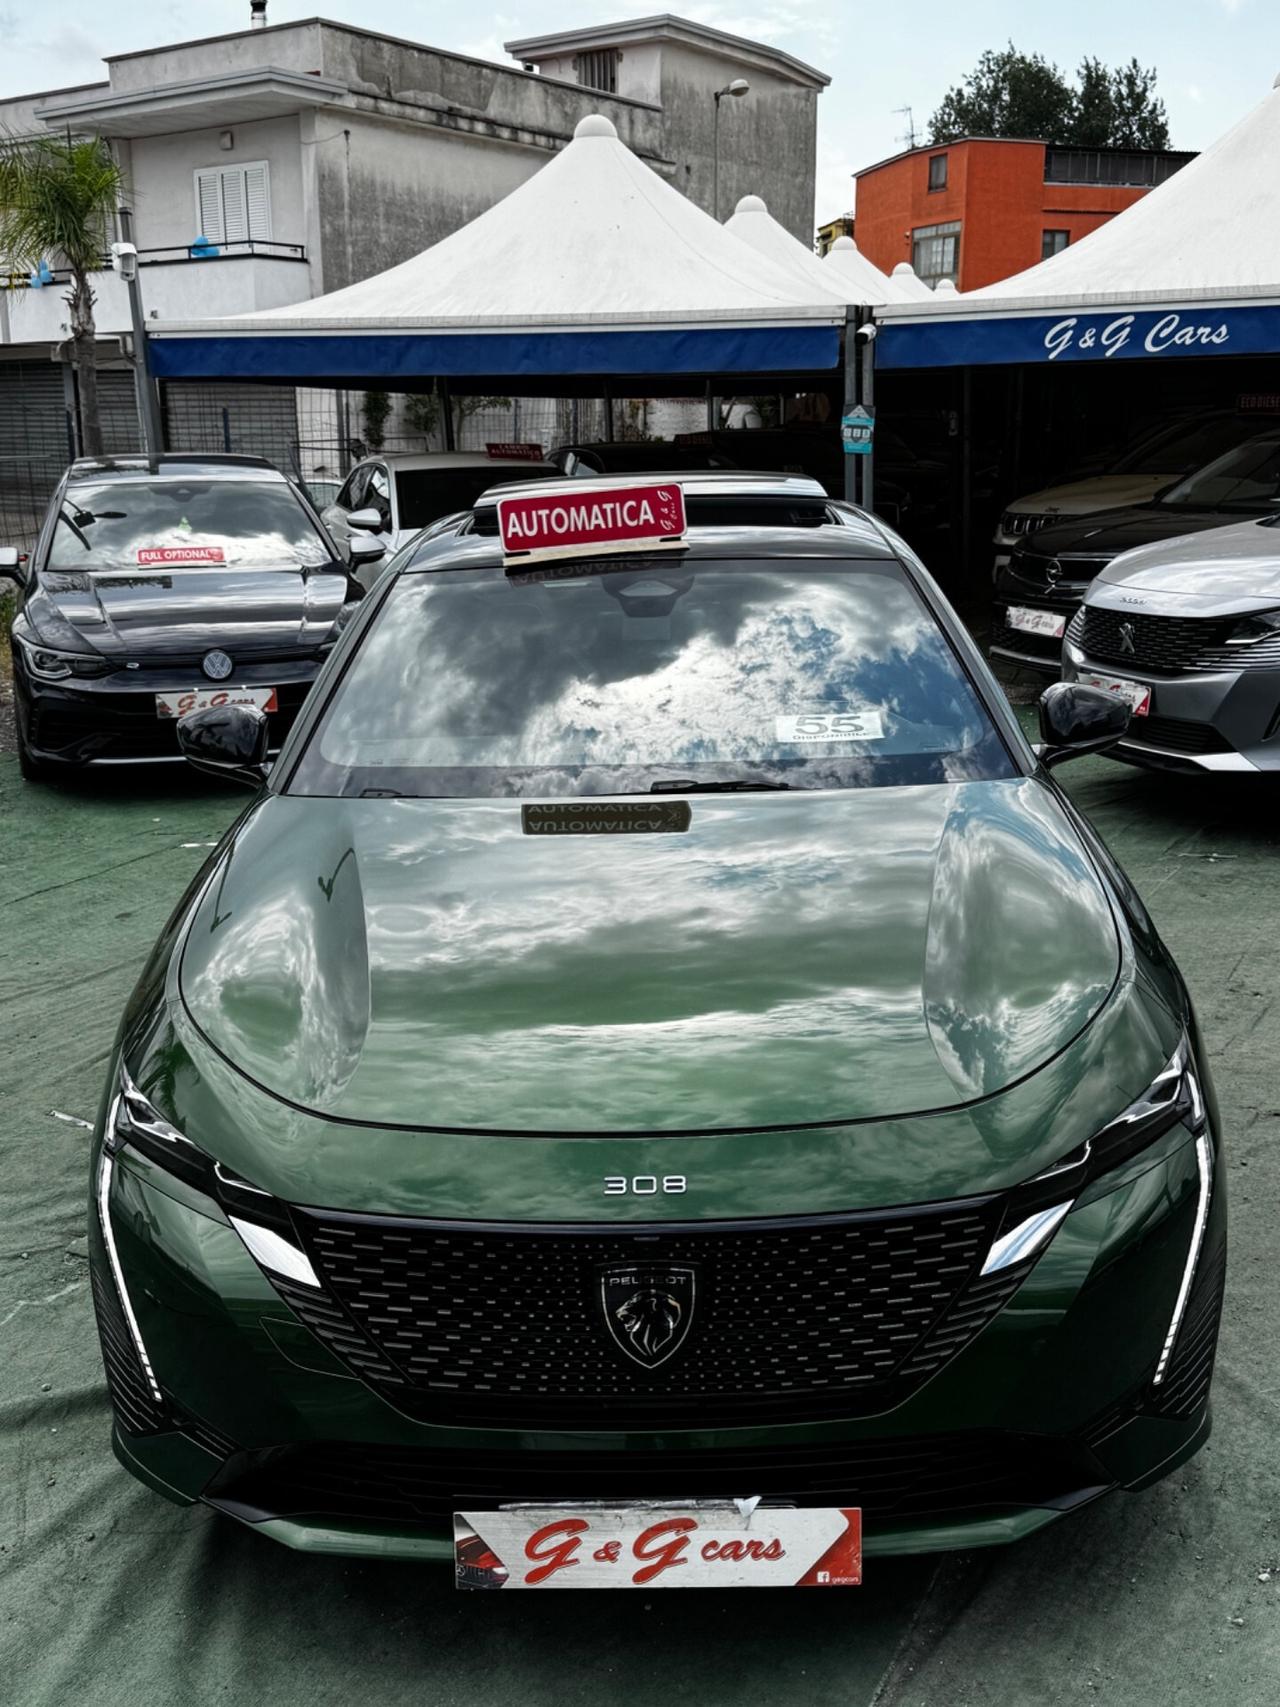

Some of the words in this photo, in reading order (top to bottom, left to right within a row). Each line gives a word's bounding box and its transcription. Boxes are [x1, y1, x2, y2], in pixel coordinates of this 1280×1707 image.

[1144, 314, 1230, 353] Cars
[507, 499, 656, 539] AUTOMATICA
[141, 551, 163, 561] FULL
[164, 549, 211, 560] OPTIONAL
[795, 715, 864, 735] 55
[603, 1175, 687, 1195] 308
[701, 1538, 786, 1563] cars
